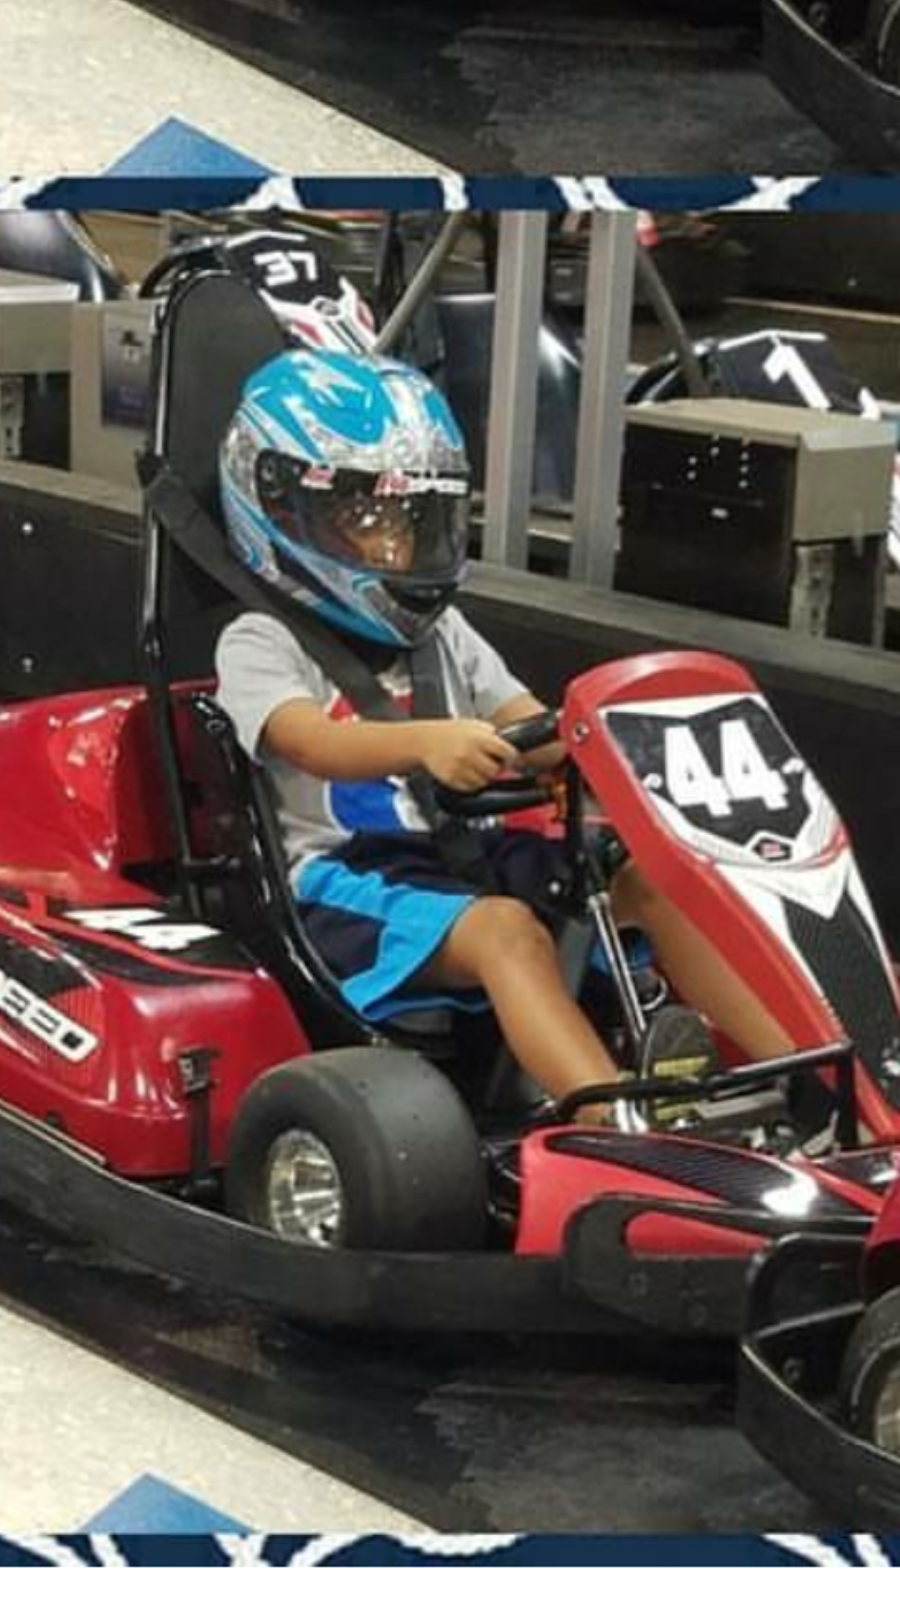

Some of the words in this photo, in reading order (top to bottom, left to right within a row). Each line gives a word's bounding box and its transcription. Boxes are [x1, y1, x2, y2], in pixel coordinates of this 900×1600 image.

[253, 251, 317, 287] 37
[763, 345, 831, 409] 1
[664, 719, 788, 817] 44
[62, 908, 222, 950] 44
